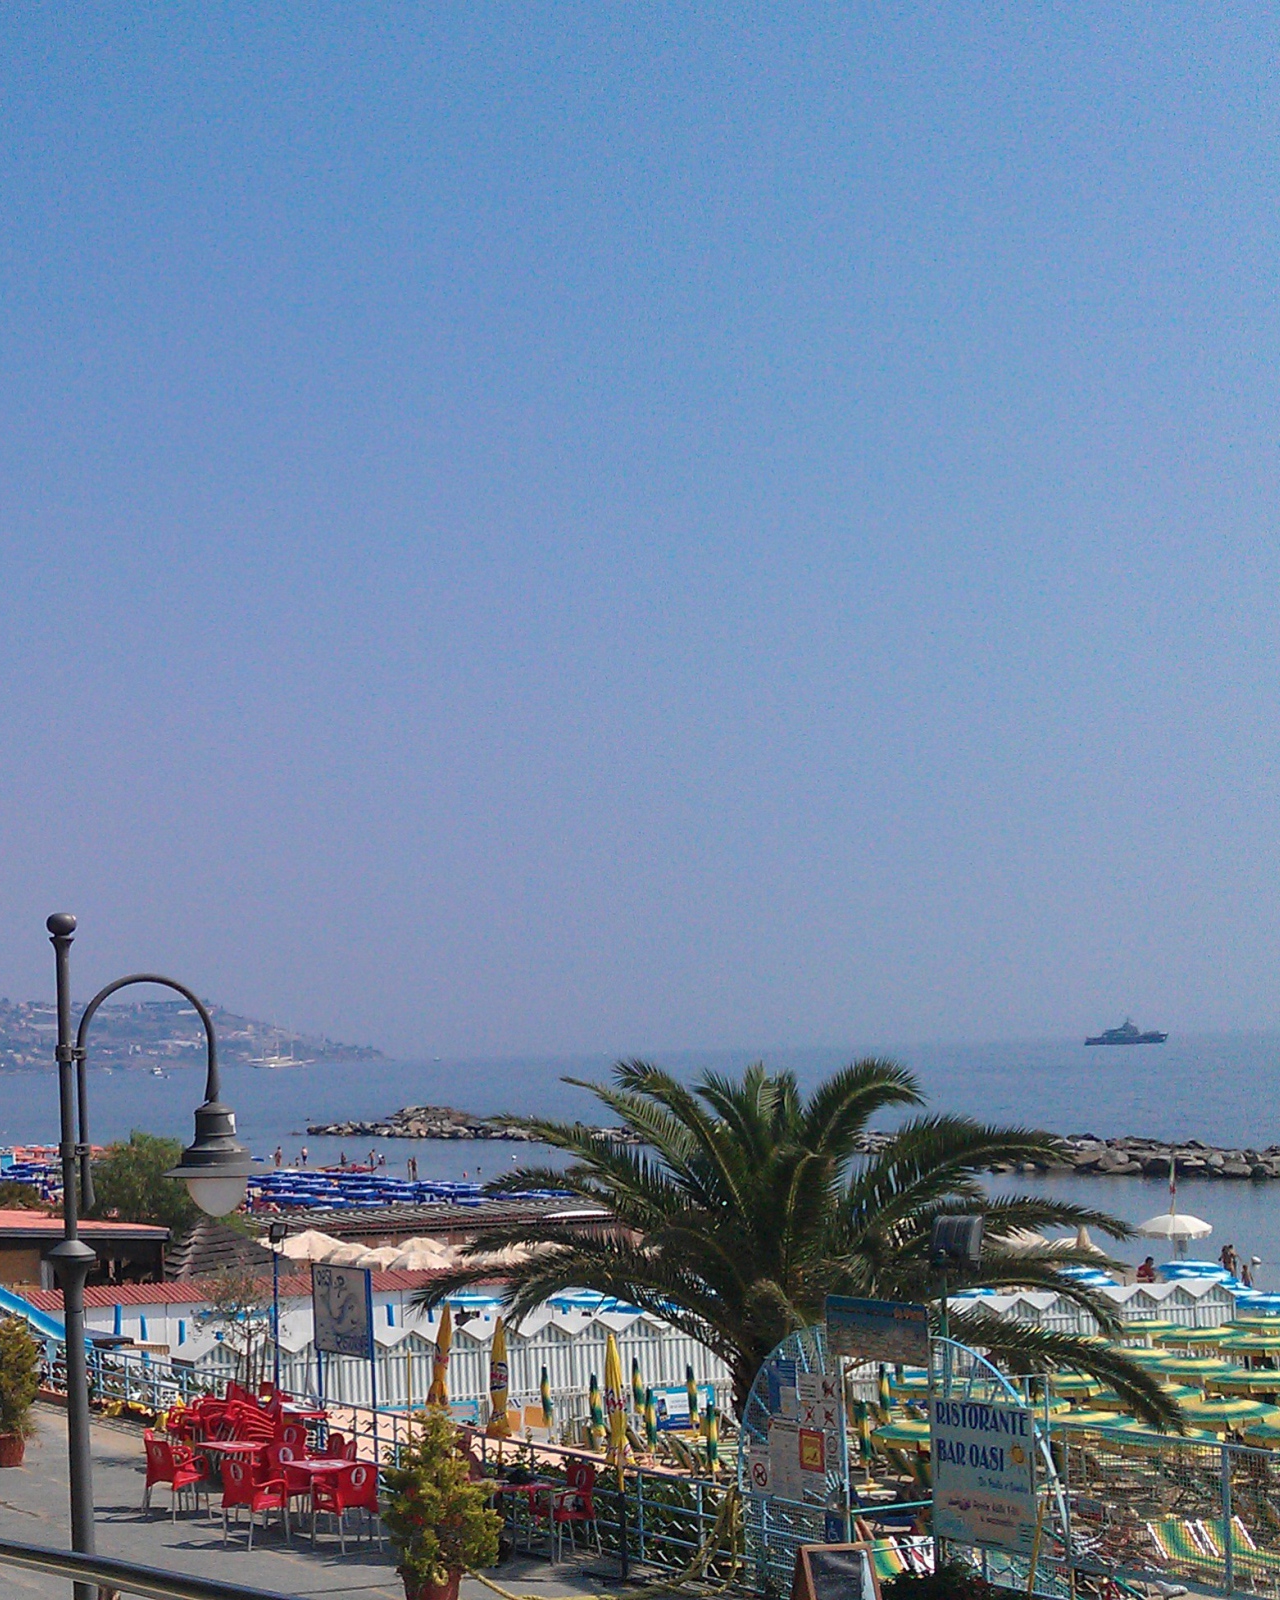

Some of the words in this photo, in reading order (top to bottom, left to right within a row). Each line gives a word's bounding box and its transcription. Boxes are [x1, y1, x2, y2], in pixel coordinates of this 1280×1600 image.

[936, 1401, 1028, 1436] RISTORANTE
[936, 1438, 966, 1466] BAR
[969, 1444, 1004, 1472] OASI
